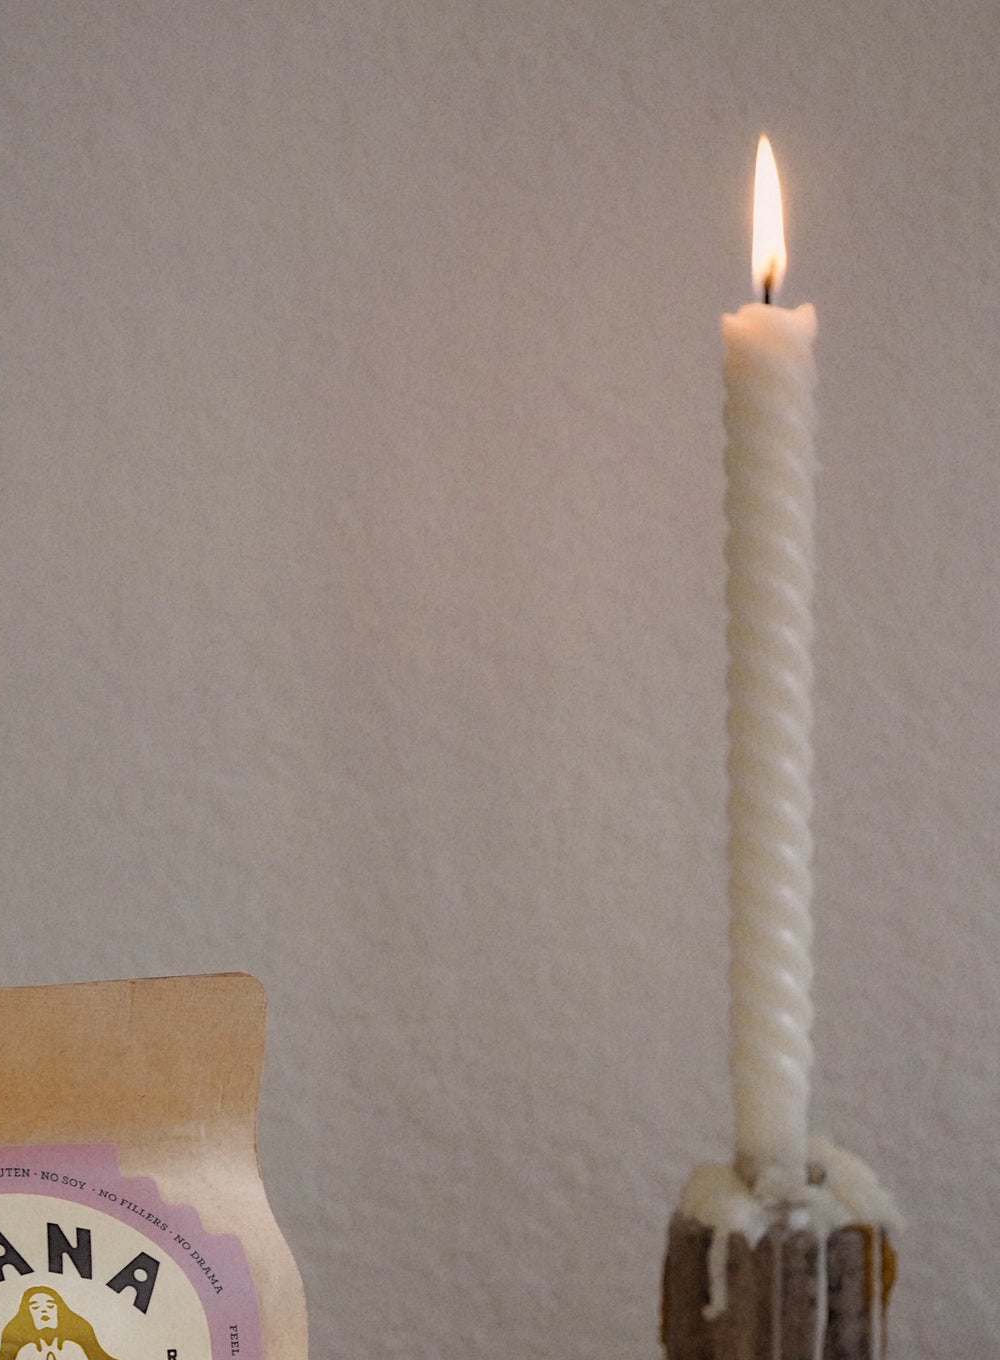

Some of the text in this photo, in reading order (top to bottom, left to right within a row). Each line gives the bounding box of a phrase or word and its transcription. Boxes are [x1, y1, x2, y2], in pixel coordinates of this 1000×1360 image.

[40, 1170, 59, 1182] NO
[61, 1176, 87, 1190] SOY
[98, 1188, 118, 1202] NO
[119, 1198, 168, 1232] FILLERS
[173, 1234, 191, 1251] NO
[190, 1251, 224, 1295] DRAMA
[228, 1324, 239, 1356] FEEL
